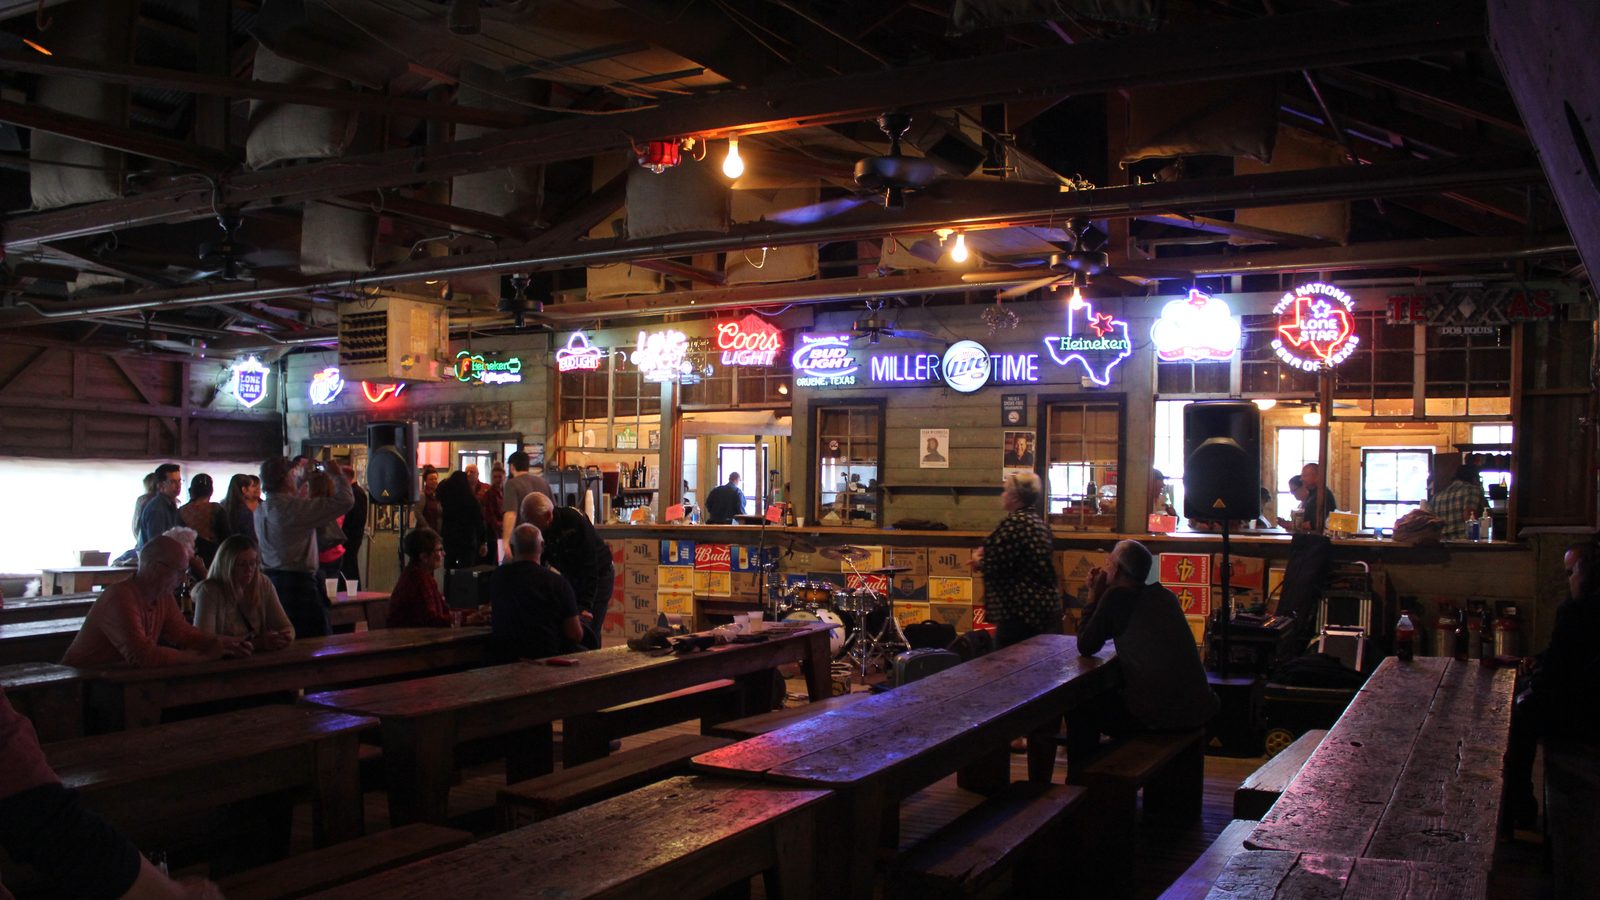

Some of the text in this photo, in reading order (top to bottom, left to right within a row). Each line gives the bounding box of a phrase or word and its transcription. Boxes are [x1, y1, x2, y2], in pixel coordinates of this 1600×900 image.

[1272, 283, 1356, 315] THE NATIONAL
[717, 322, 781, 351] Coors
[1299, 330, 1339, 342] STAR
[1060, 337, 1129, 352] Heineken
[721, 350, 776, 366] LIGHT
[809, 348, 848, 359] BUD
[1302, 360, 1321, 372] OF
[1324, 335, 1360, 368] TEXAS
[801, 357, 854, 369] LIGHT
[871, 354, 1039, 382] MILLER TIME
[240, 374, 261, 384] LONE
[829, 375, 855, 386] TEXAS
[240, 384, 261, 393] STAR
[1178, 558, 1193, 582] 4
